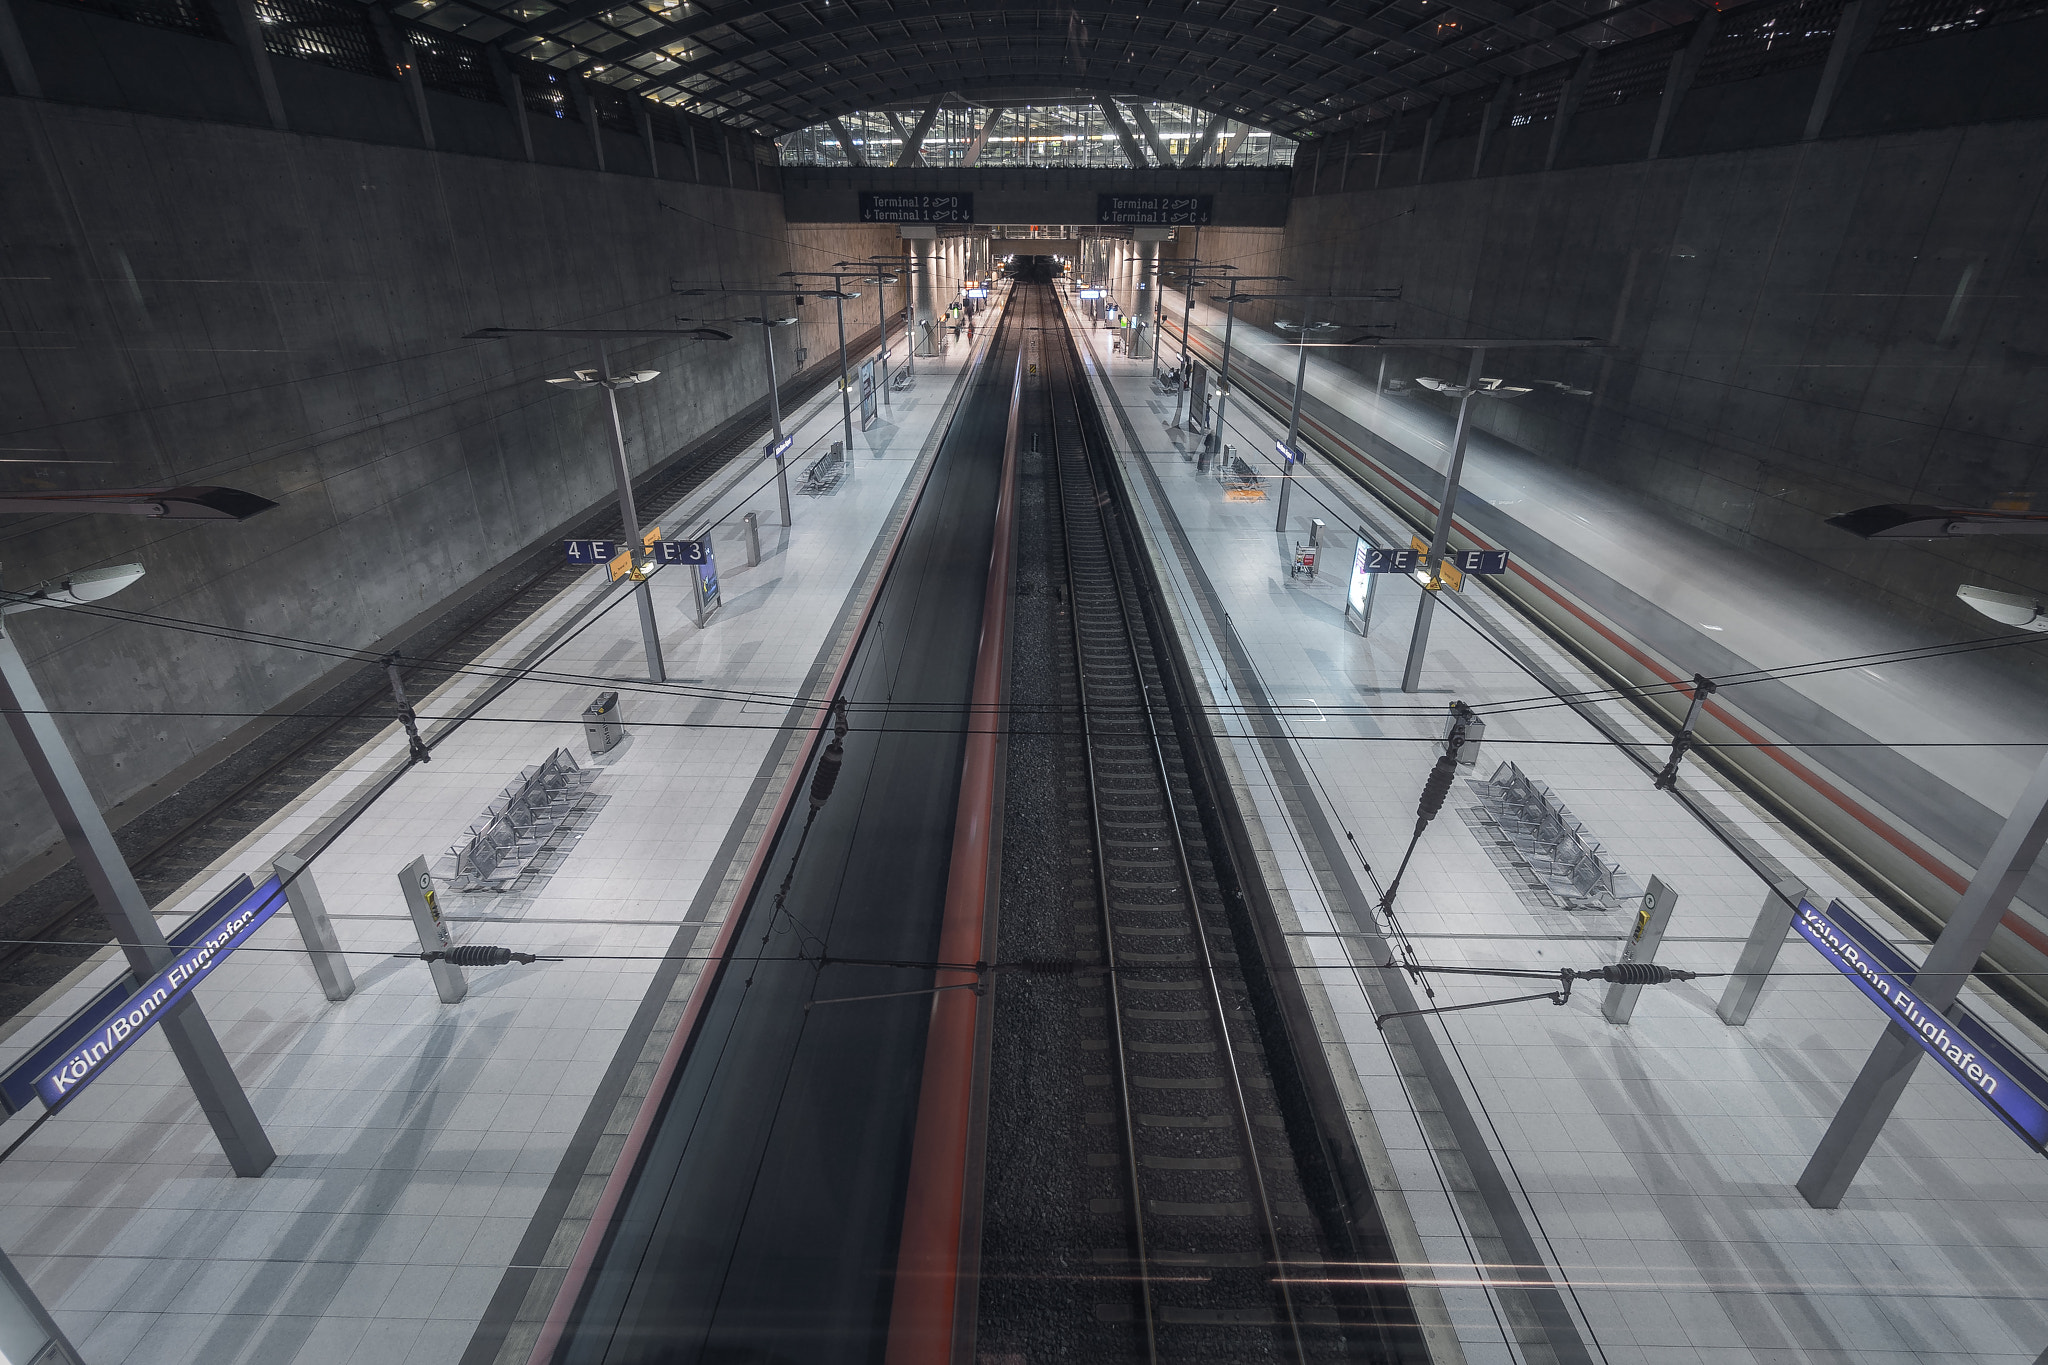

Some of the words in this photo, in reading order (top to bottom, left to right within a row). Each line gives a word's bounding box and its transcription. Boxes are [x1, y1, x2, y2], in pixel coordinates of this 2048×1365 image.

[873, 196, 919, 208] Terminal
[923, 196, 930, 208] 2
[951, 196, 958, 208] D
[1112, 198, 1158, 210] Terminal
[1162, 198, 1169, 210] 2
[1191, 198, 1197, 210] D
[873, 209, 919, 221] Terminal
[923, 209, 929, 221] 1
[951, 209, 958, 221] C
[1112, 211, 1157, 223] Terminal
[1162, 211, 1168, 223] 1
[1190, 211, 1196, 223] C
[568, 541, 581, 559] 4
[592, 542, 607, 559] E
[663, 543, 677, 560] E
[689, 543, 702, 560] 3
[1369, 551, 1383, 568] 2
[1394, 551, 1409, 569] E
[1465, 552, 1480, 569] E
[1497, 552, 1507, 570] 1
[51, 986, 168, 1095] Köln/Bonn
[167, 908, 255, 990] Flughafen
[1801, 909, 1891, 1000] Köln/Bonn
[1892, 990, 1999, 1095] Flughafen
